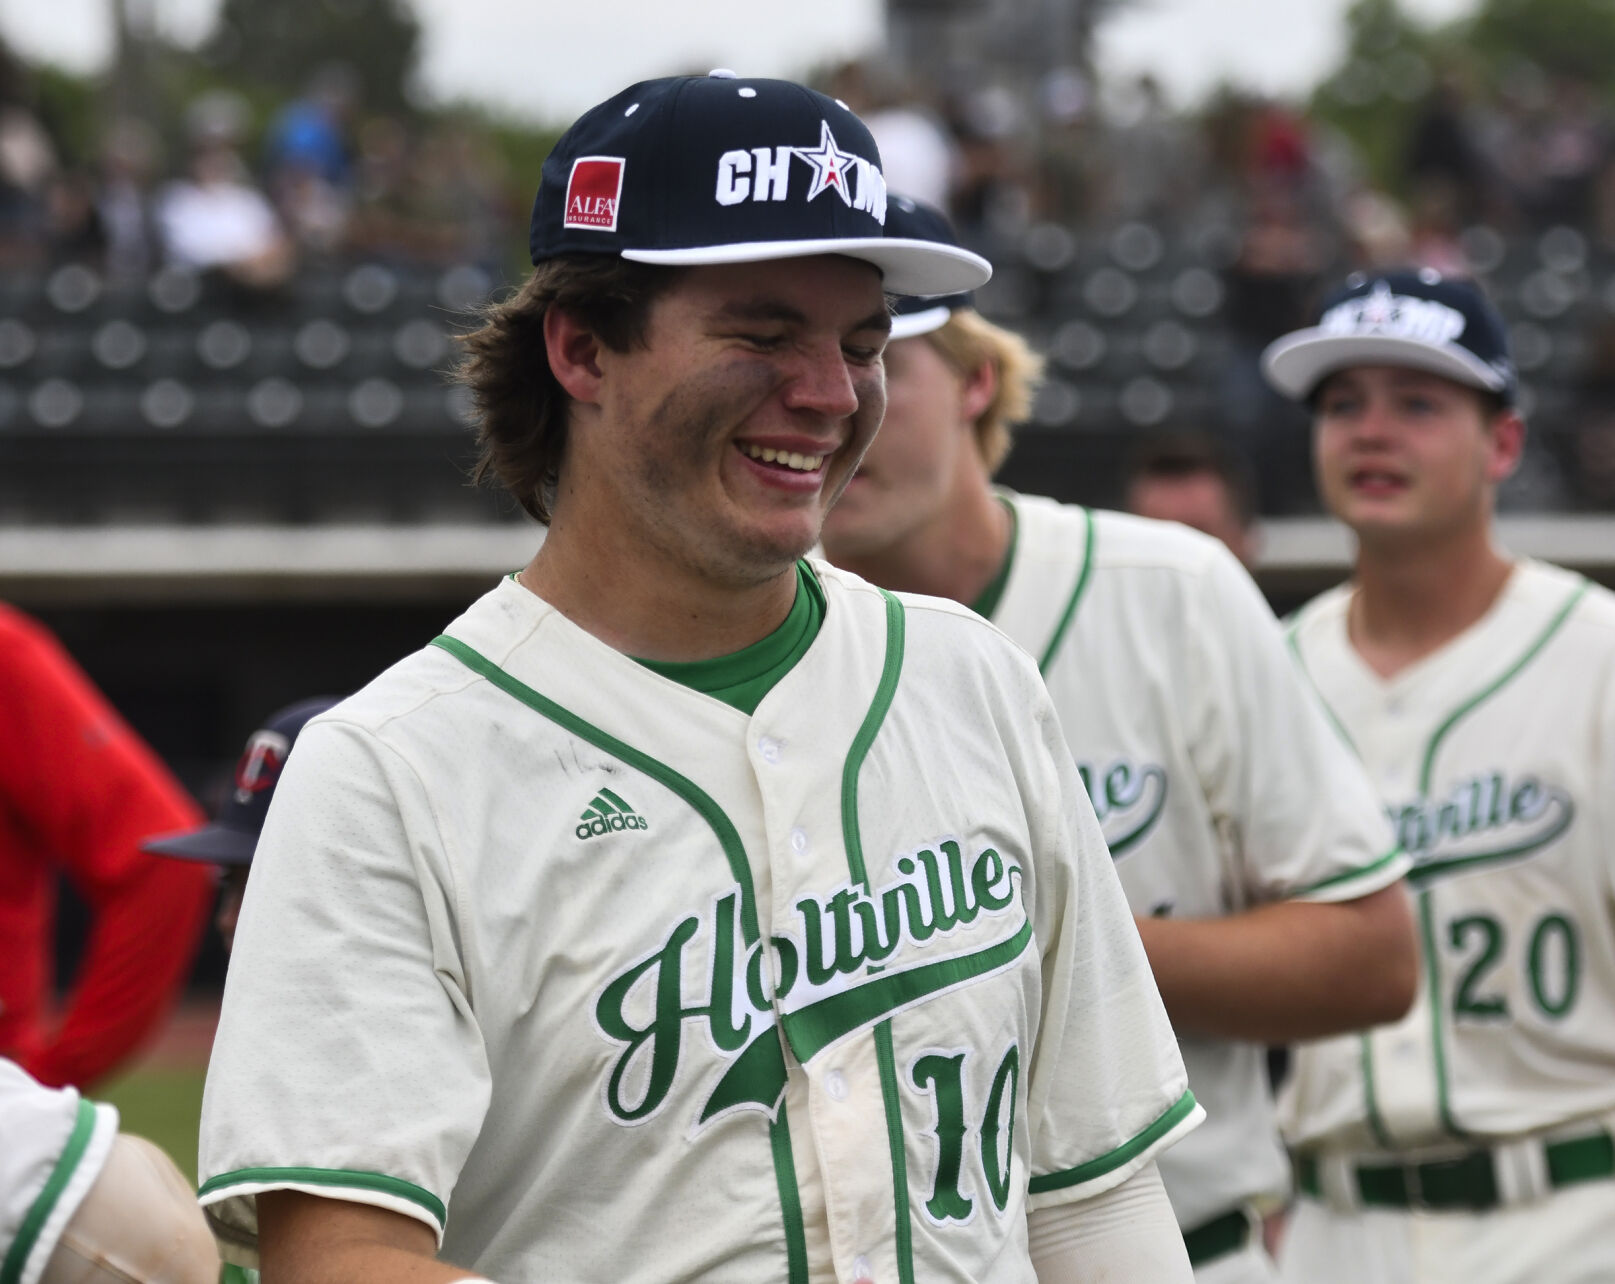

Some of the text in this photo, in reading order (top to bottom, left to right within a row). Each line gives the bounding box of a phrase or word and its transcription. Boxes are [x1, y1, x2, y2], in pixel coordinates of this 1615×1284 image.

[569, 195, 616, 216] ALFA
[575, 812, 649, 840] adidas
[591, 835, 1024, 1127] Holtville
[1450, 911, 1581, 1020] 20
[908, 1041, 1020, 1228] 10
